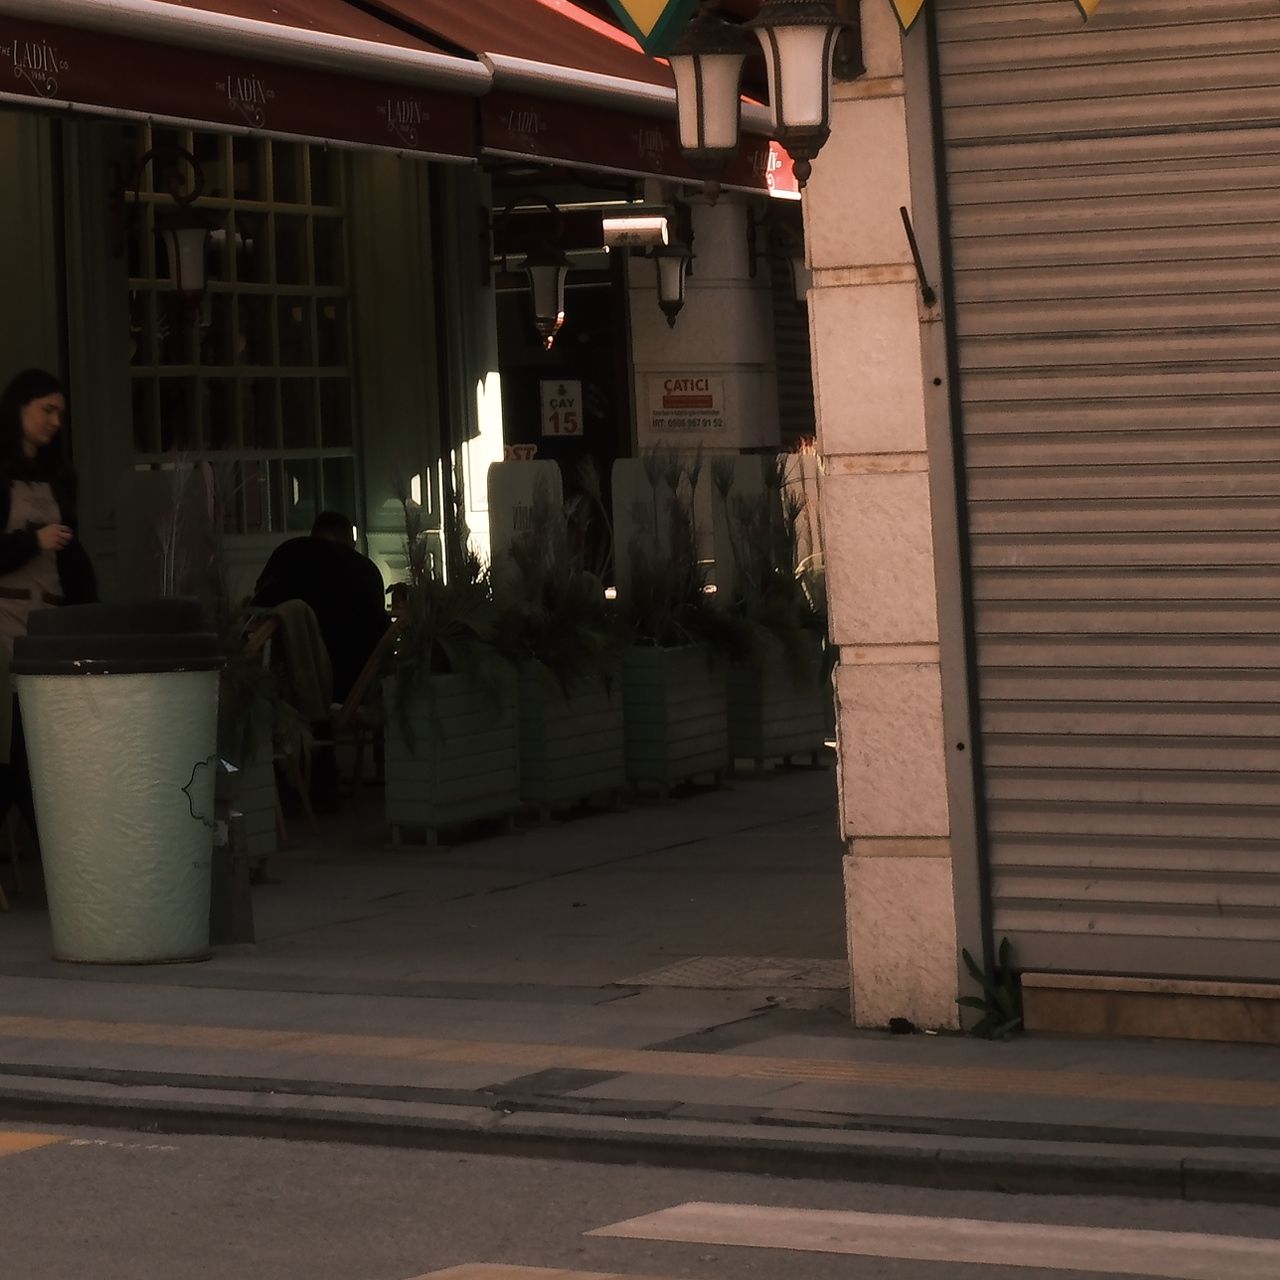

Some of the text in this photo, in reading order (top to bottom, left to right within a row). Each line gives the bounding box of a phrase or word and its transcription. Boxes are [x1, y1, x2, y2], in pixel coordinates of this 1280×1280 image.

[663, 378, 709, 395] ÇATICI
[549, 398, 575, 410] ÇAY
[549, 411, 578, 433] 15
